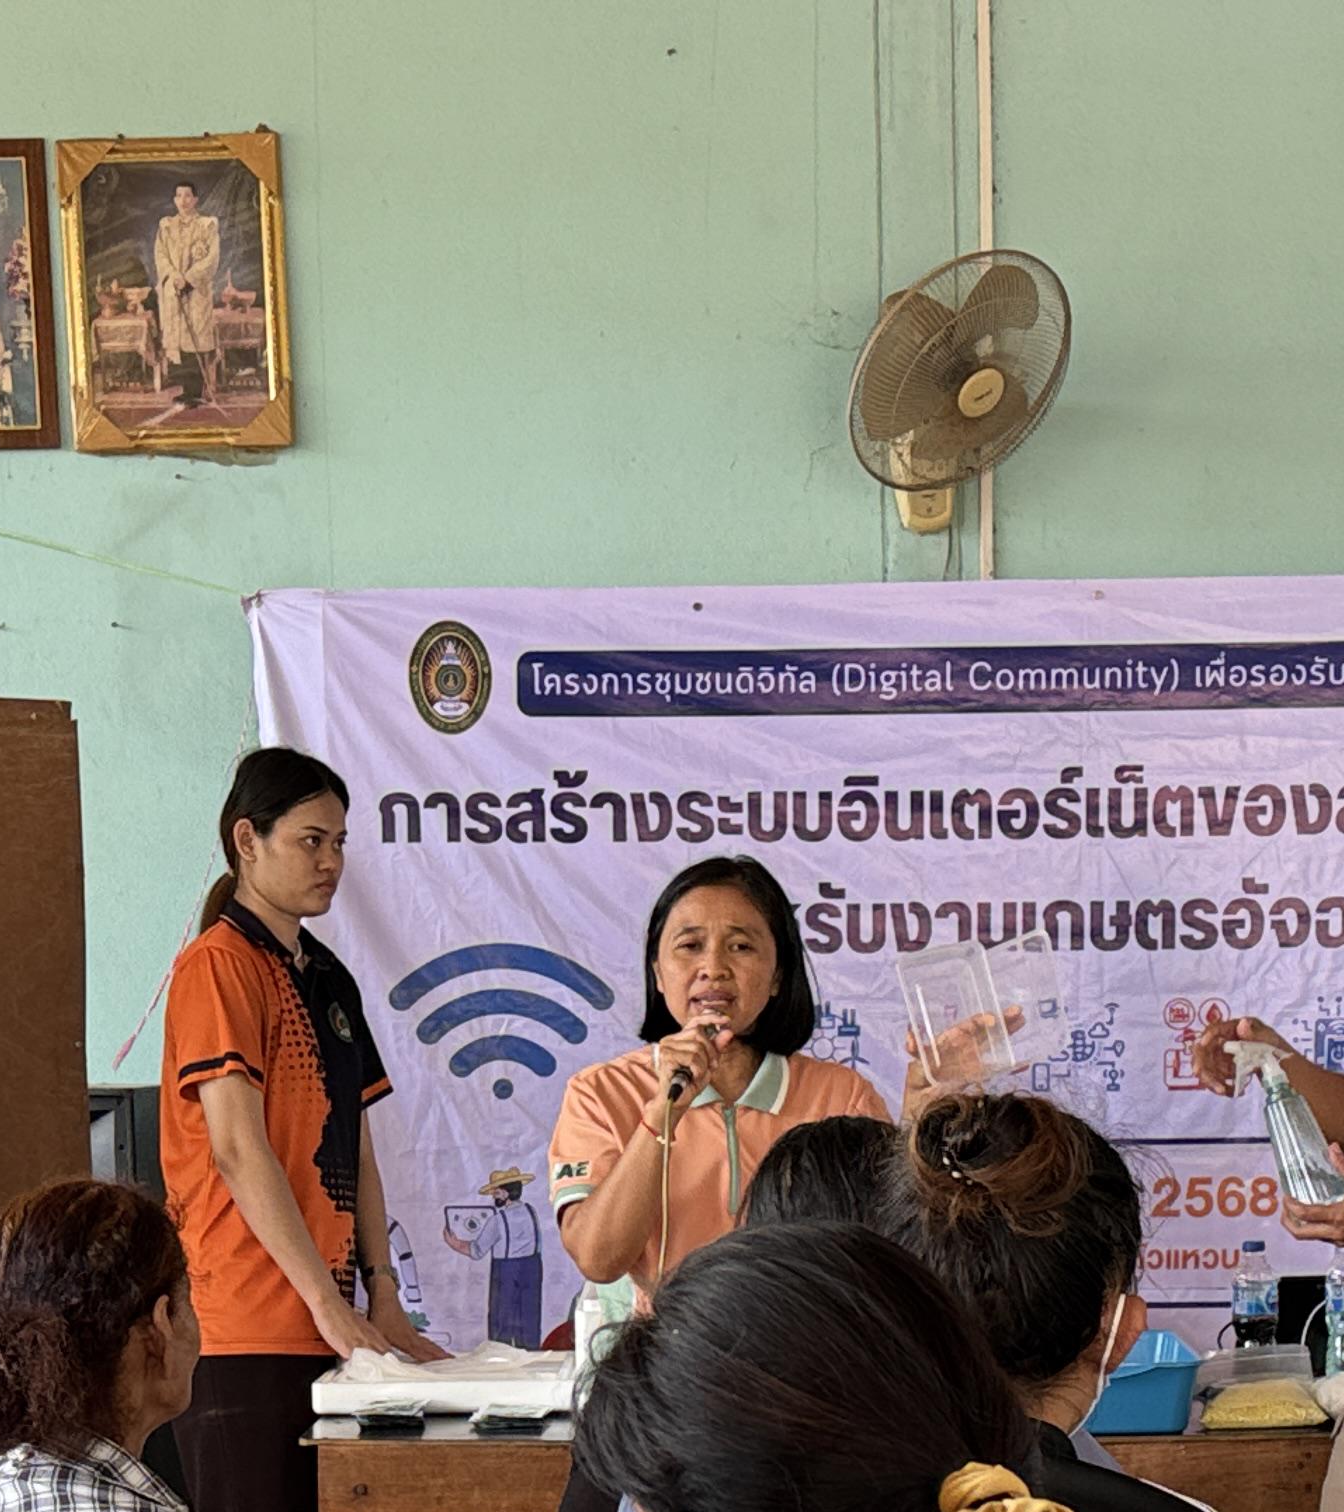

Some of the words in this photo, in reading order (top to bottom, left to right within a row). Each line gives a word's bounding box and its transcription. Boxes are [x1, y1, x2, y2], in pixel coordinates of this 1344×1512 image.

[530, 657, 819, 703] โครงการชุมชนดิจิทัล
[830, 659, 955, 702] (Digital
[967, 656, 1182, 694] Community)
[1150, 1176, 1279, 1218] 2568
